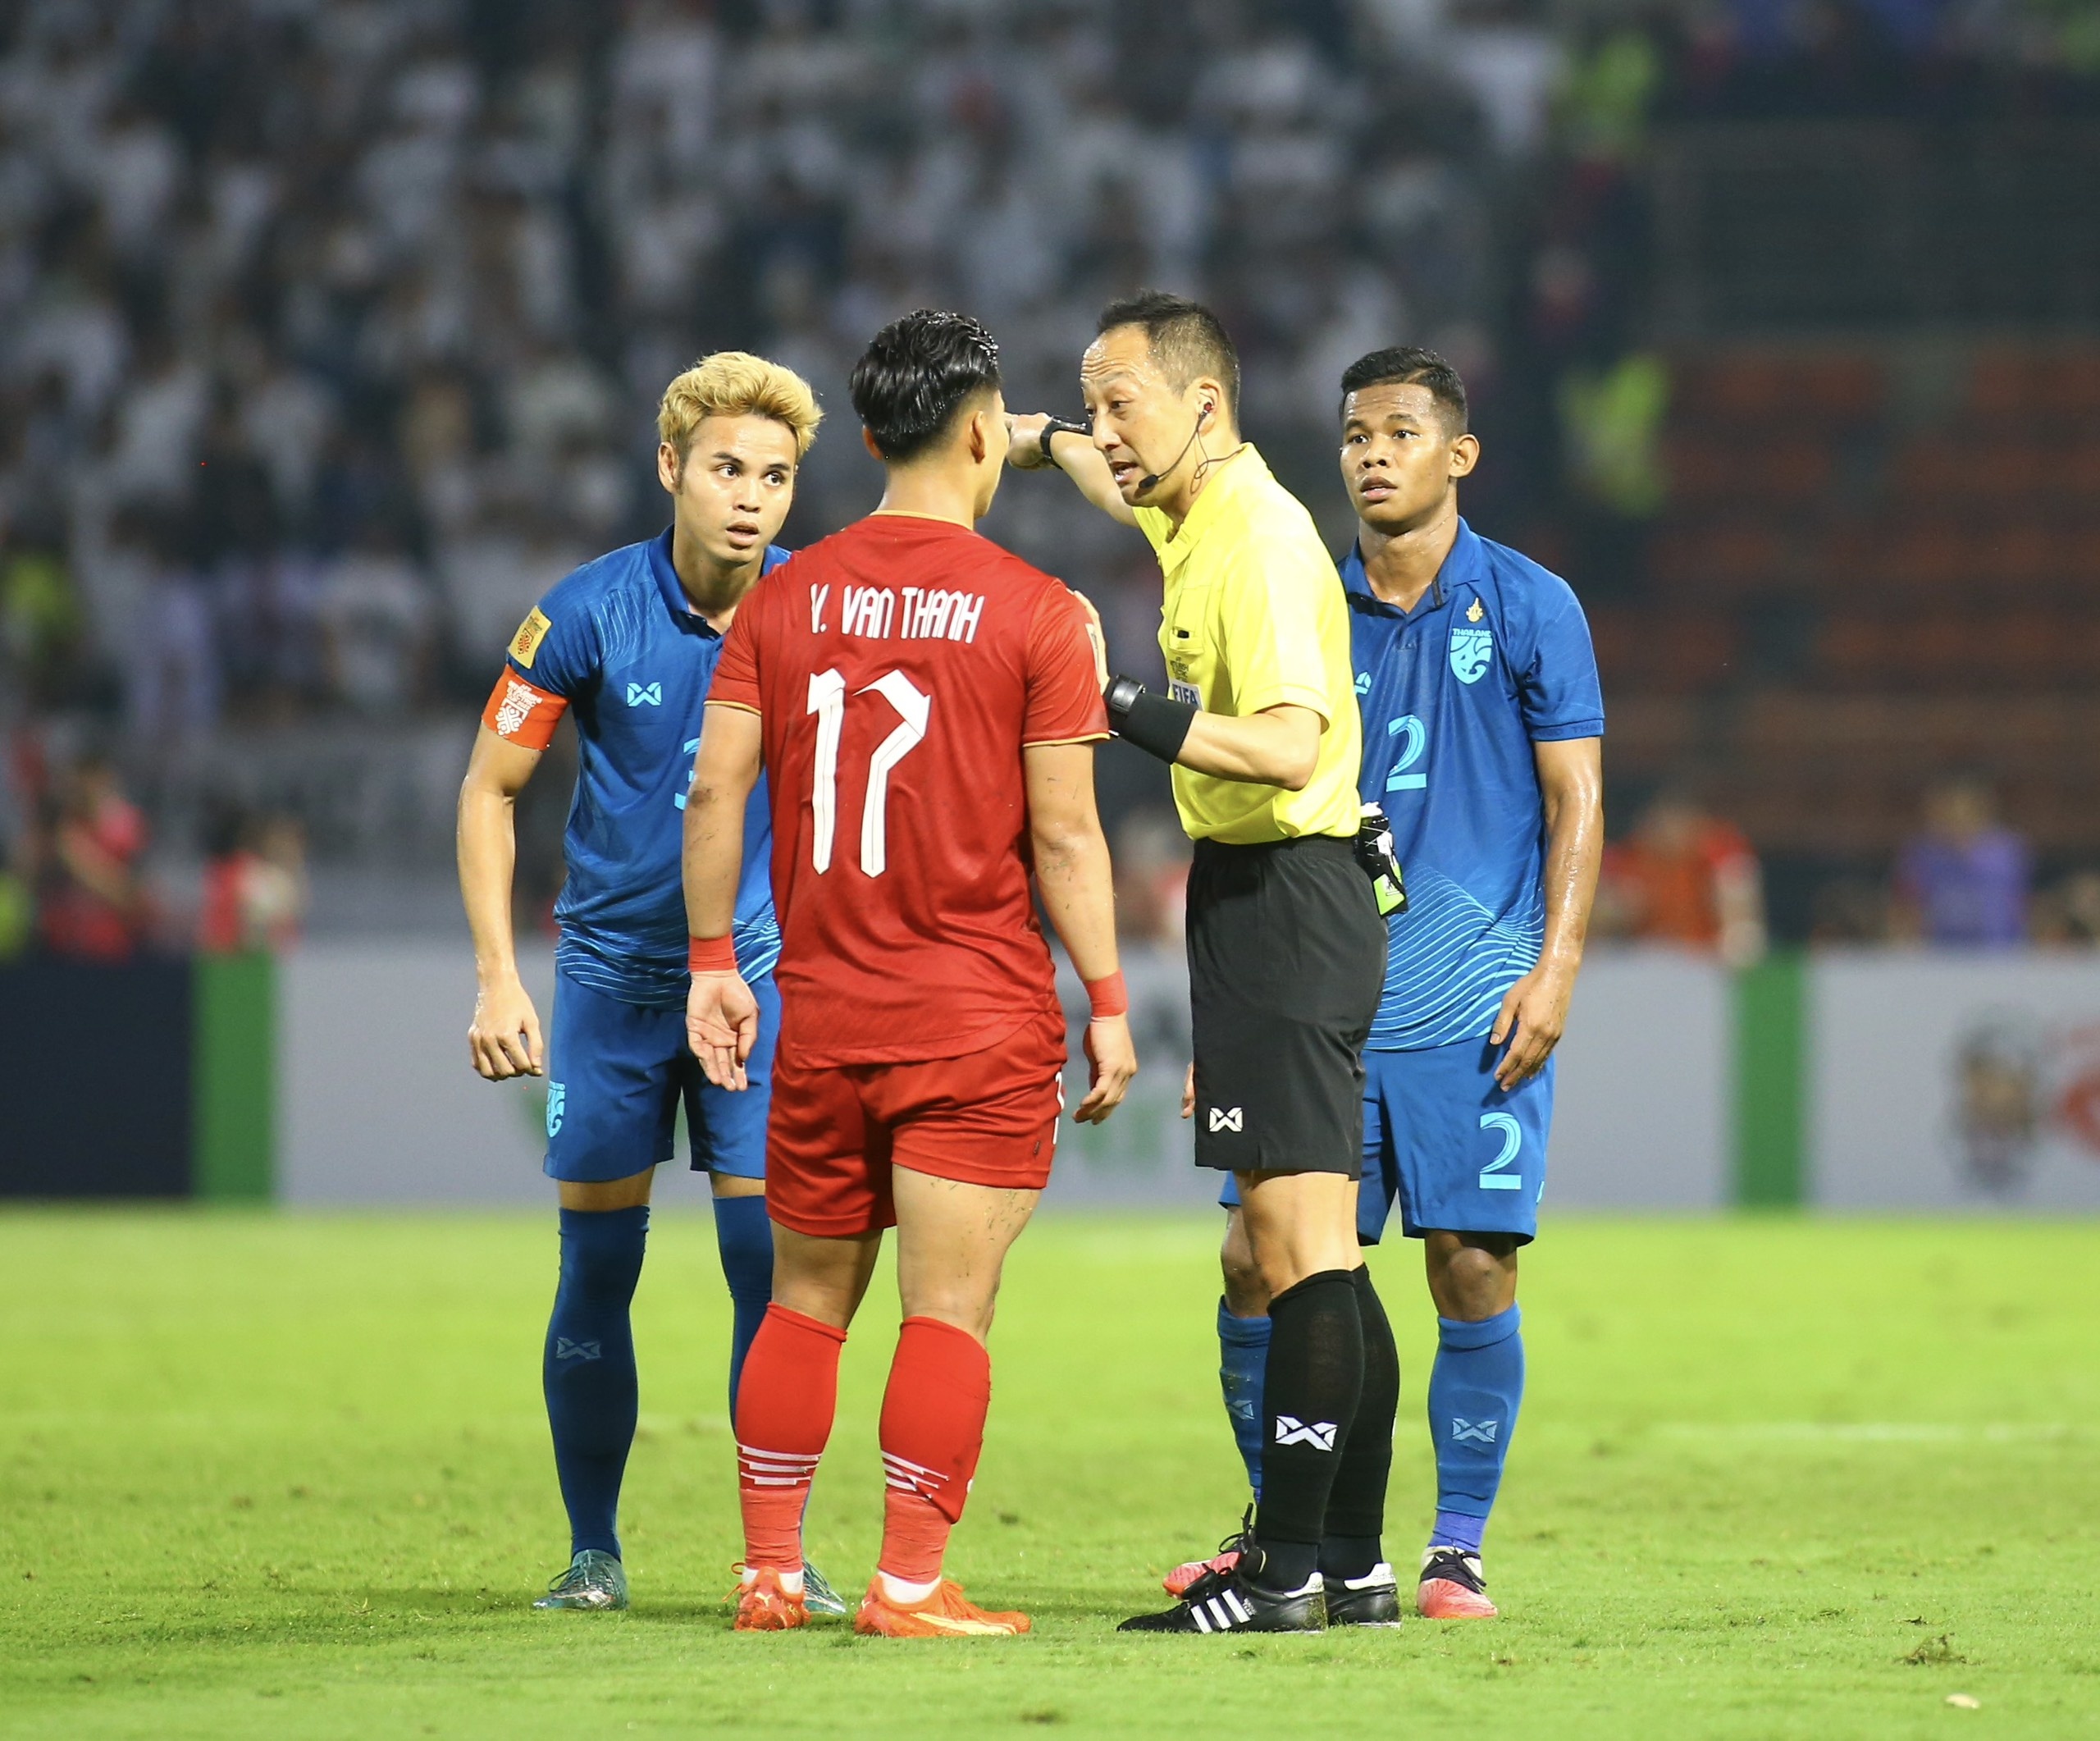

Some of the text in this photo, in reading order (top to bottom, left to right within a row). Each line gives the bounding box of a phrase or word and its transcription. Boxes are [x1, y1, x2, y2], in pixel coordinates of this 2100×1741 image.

[842, 585, 895, 639] VAN
[901, 587, 985, 644] THANH
[1173, 684, 1198, 705] FIFA
[806, 667, 931, 878] 17
[1386, 714, 1427, 793] 2
[1479, 1112, 1522, 1190] 2
